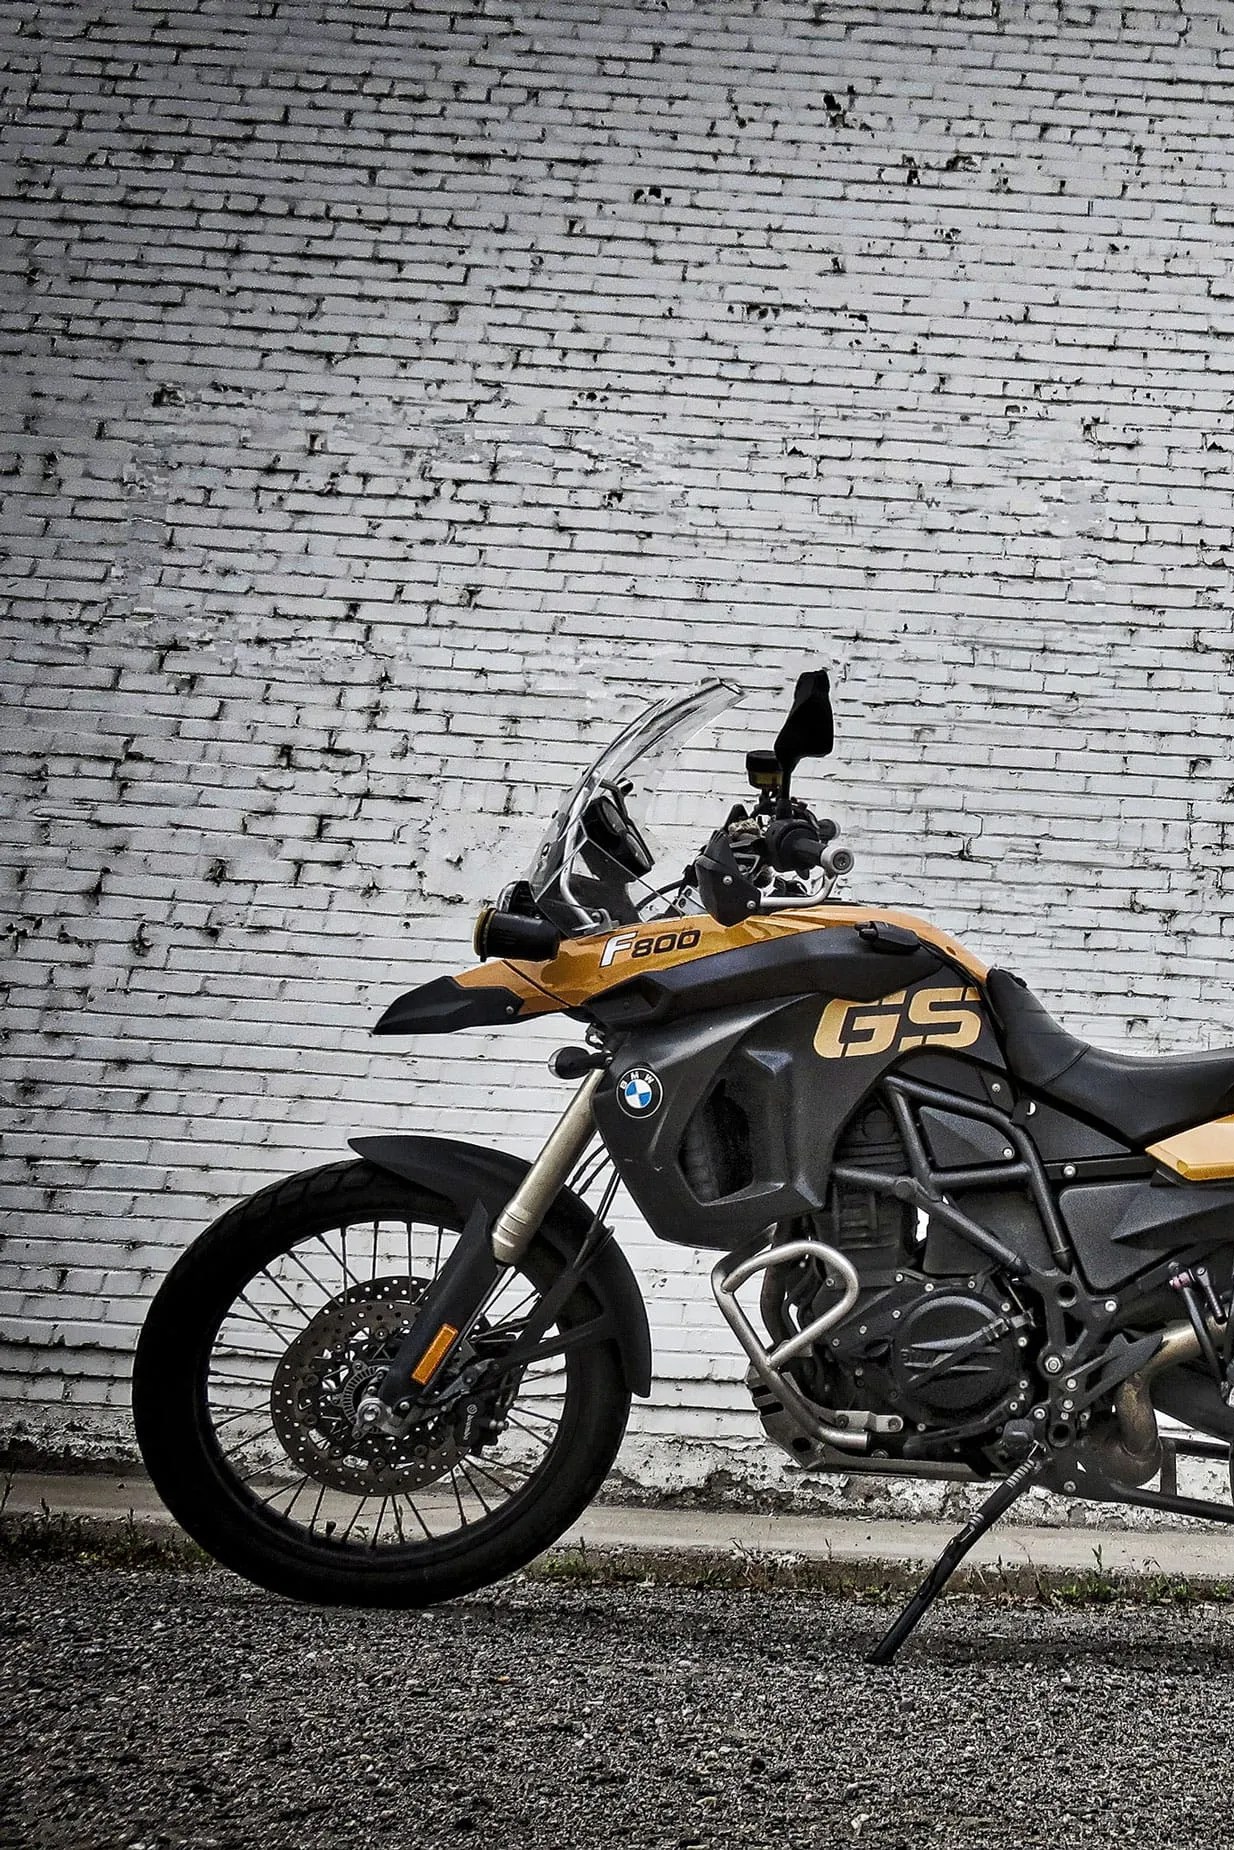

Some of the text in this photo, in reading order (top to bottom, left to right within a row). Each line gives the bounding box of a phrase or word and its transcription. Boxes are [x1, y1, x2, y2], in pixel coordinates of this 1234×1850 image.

[600, 930, 701, 968] F800
[813, 986, 982, 1059] GS
[620, 1071, 654, 1090] BMW
